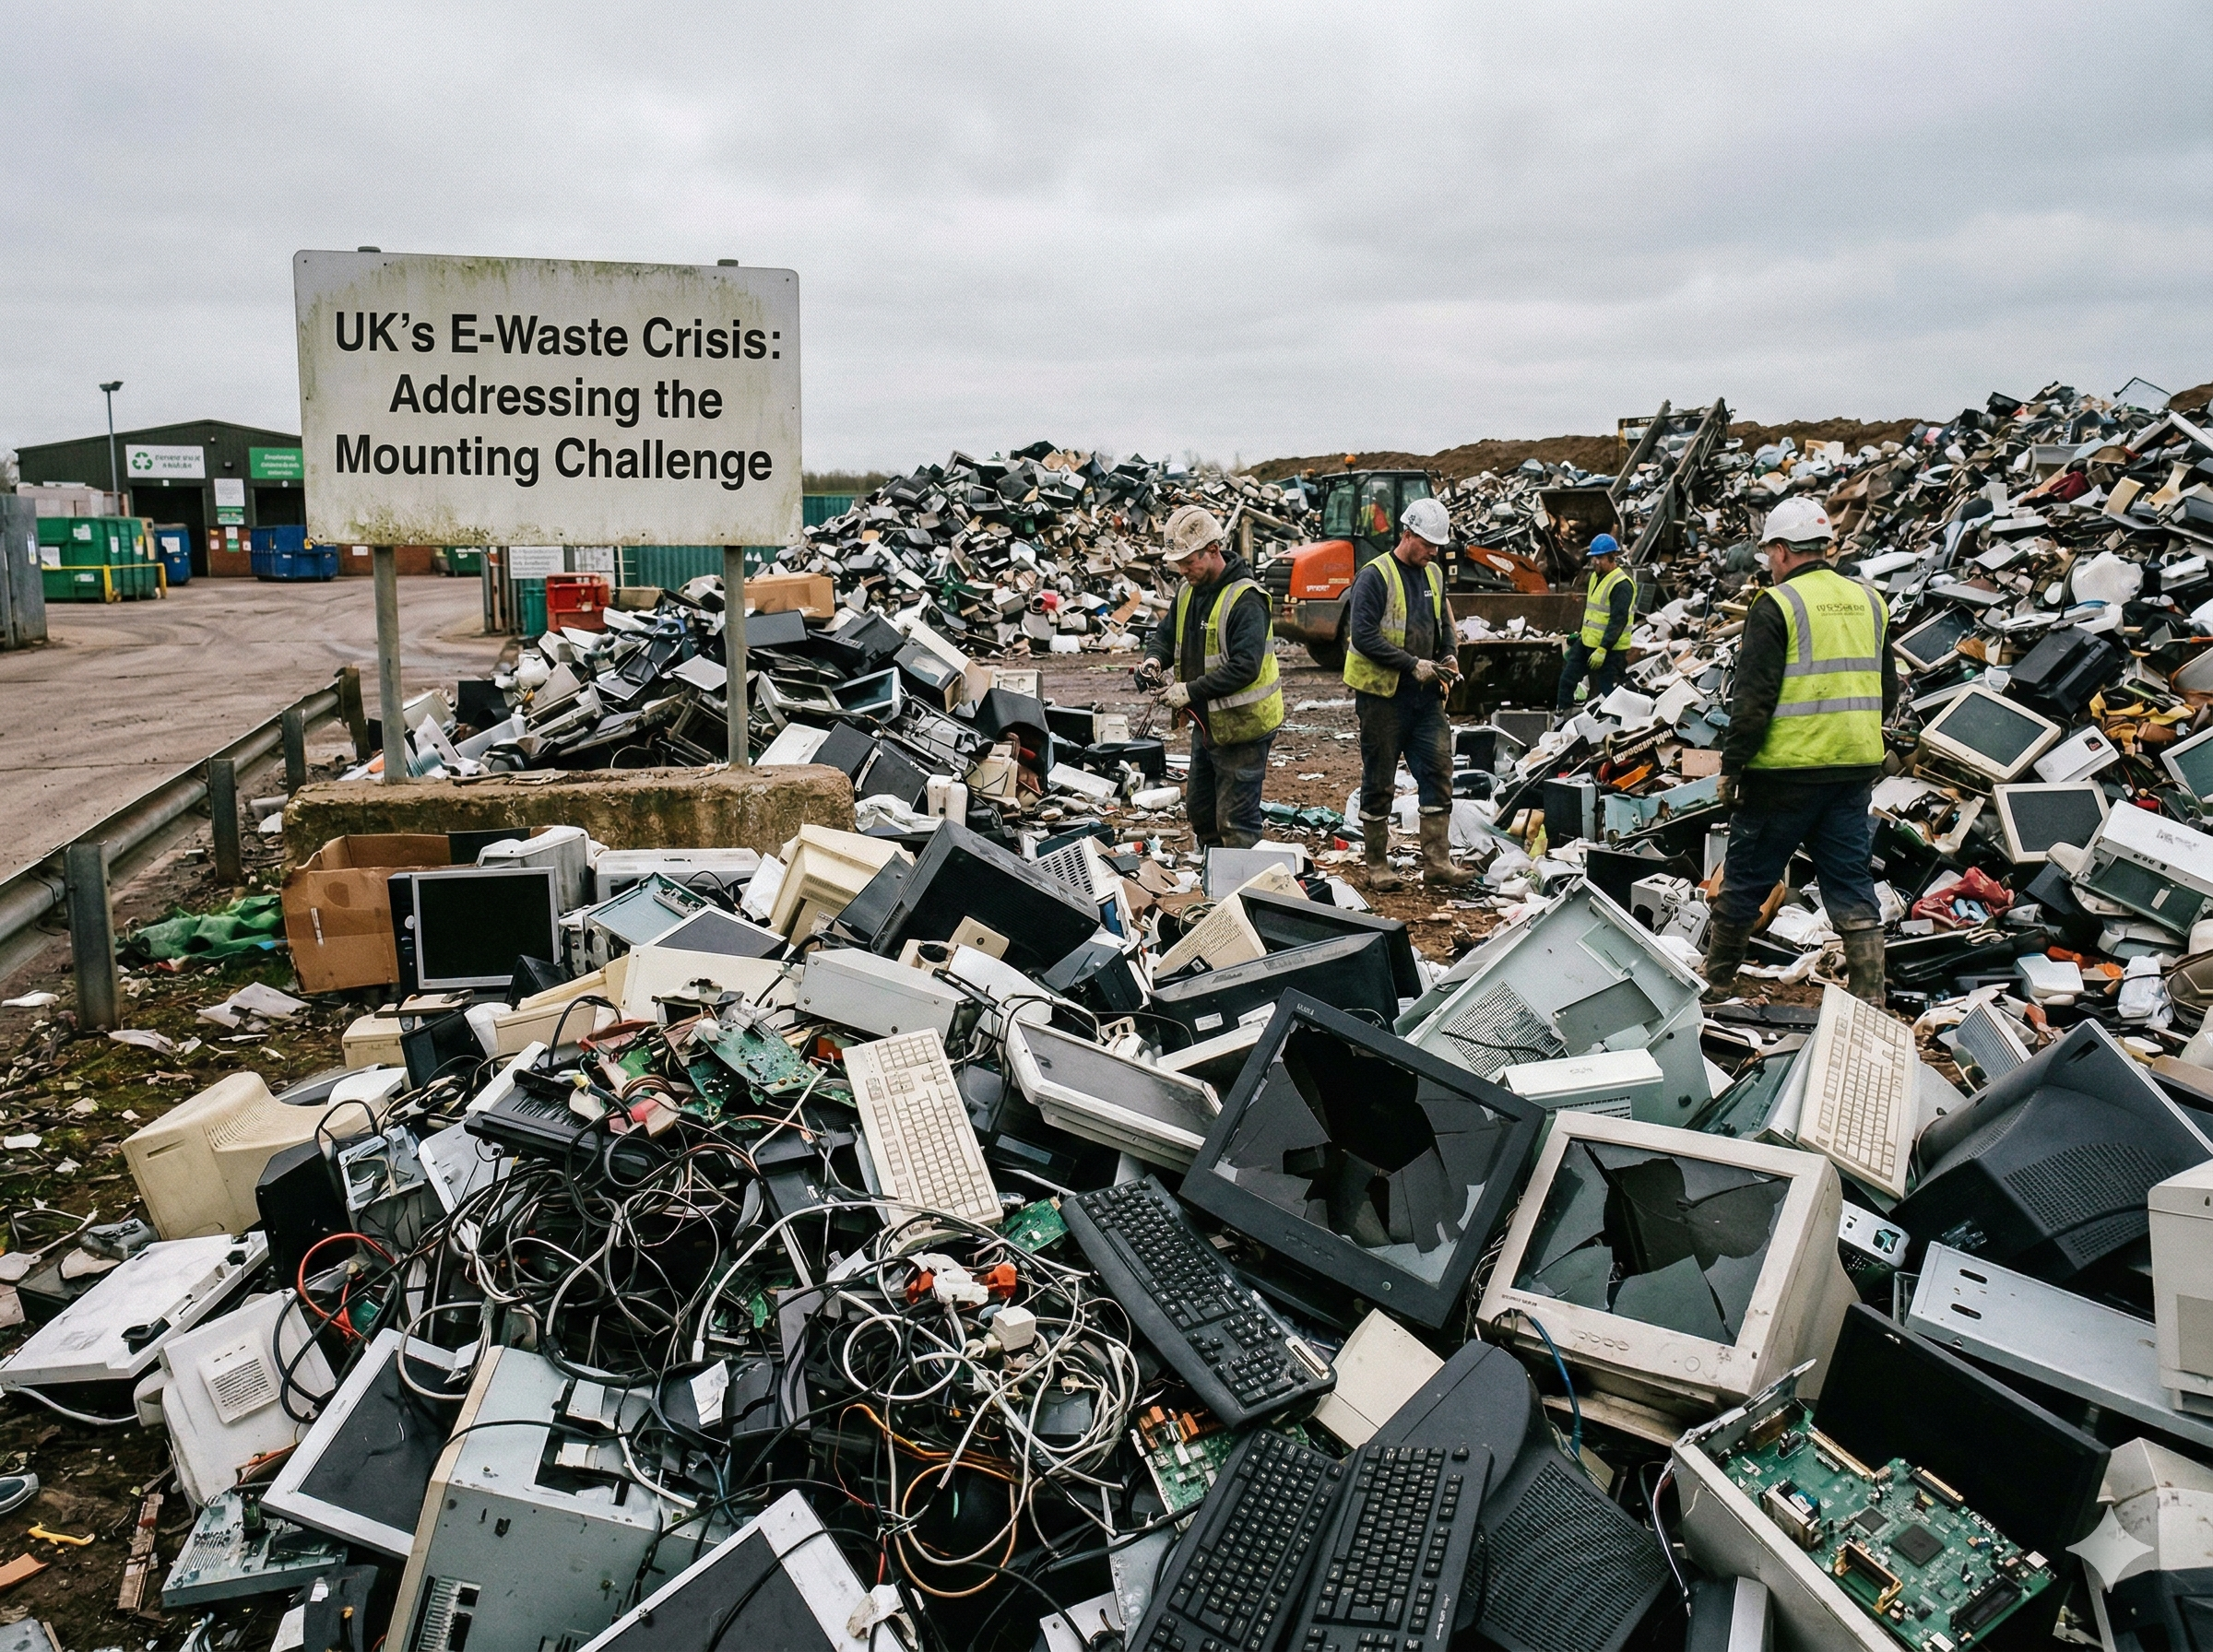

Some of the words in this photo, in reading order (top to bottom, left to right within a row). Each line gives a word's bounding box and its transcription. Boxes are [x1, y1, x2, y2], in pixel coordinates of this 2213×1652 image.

[451, 313, 628, 357] E-Waste
[643, 316, 781, 360] Crisis:
[389, 373, 640, 429] Addressing
[654, 379, 723, 419] the
[336, 434, 539, 488] Mounting
[555, 437, 773, 491] Challenge
